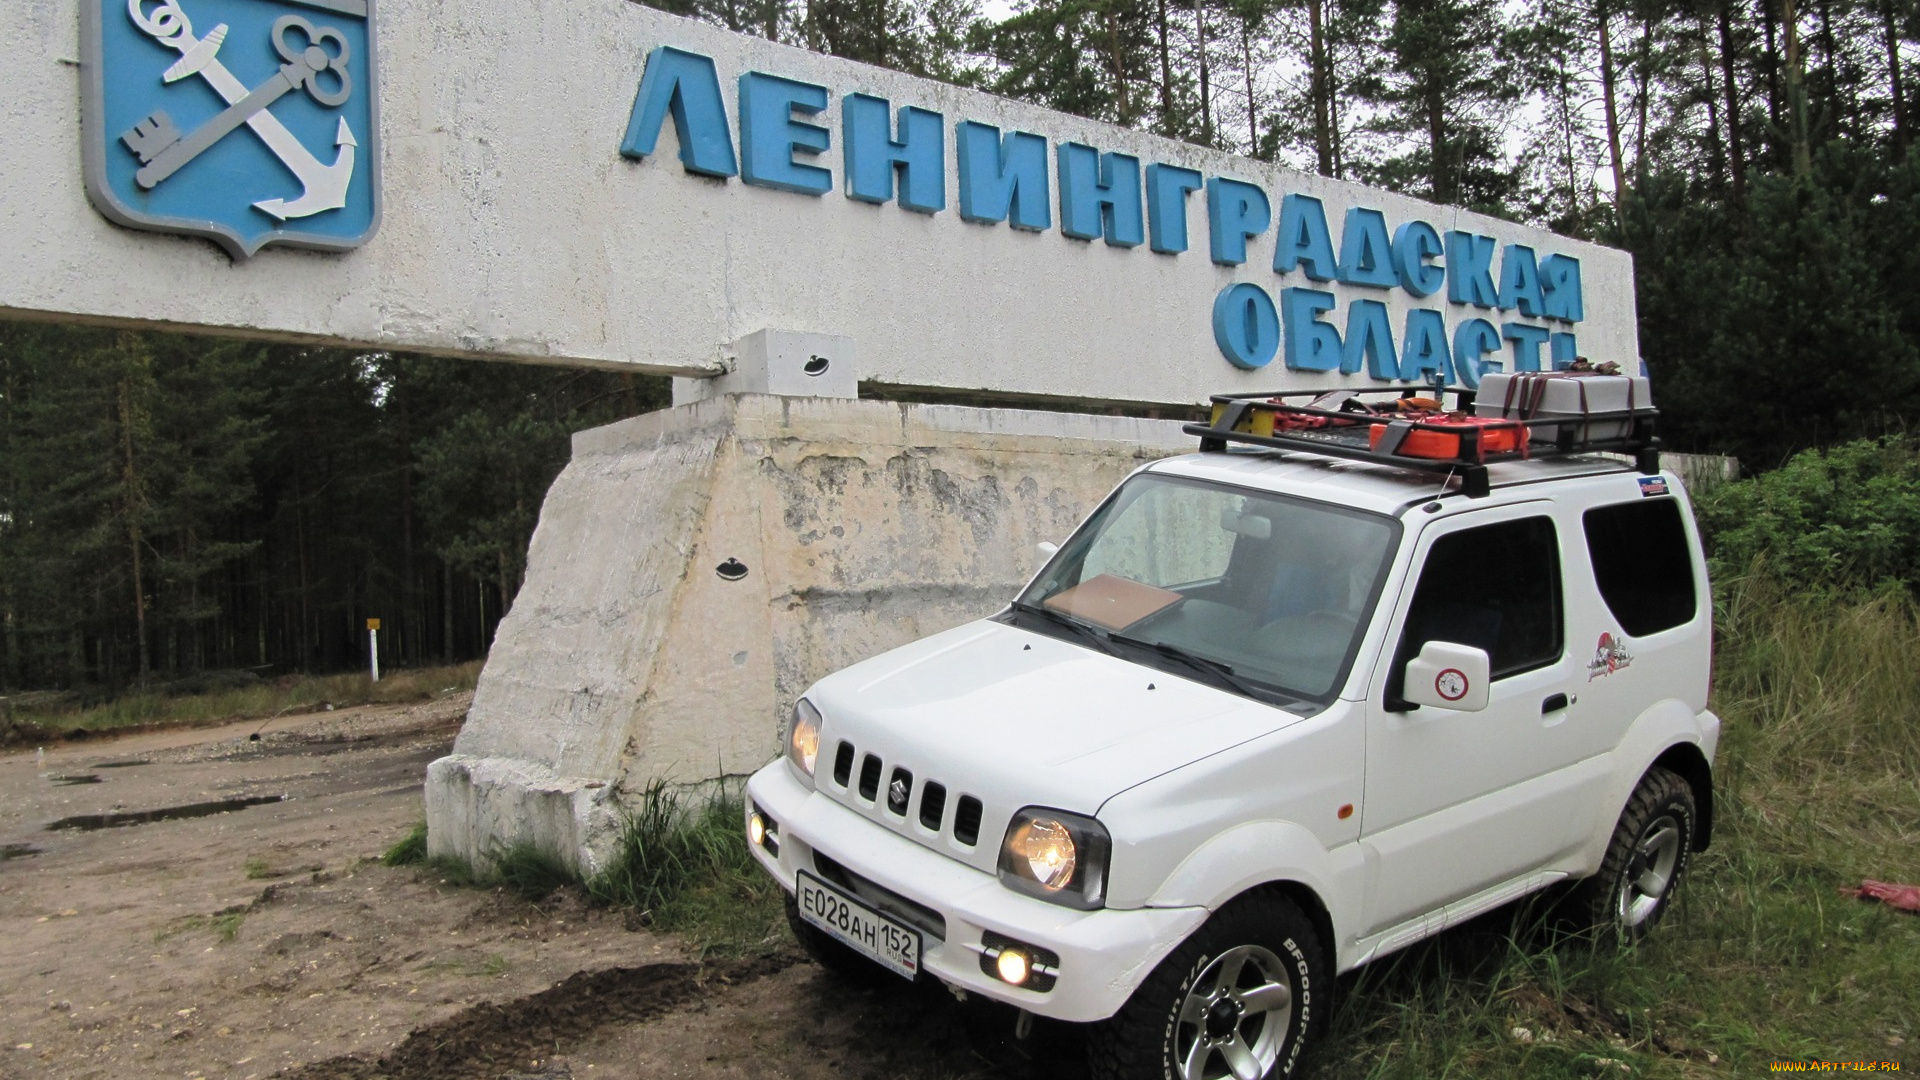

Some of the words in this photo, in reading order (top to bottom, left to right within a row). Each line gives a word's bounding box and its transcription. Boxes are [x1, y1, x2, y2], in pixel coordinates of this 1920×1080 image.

[620, 46, 1584, 323] ЛЕНИНГРАДСКАЯ
[881, 924, 912, 959] 152
[886, 947, 903, 963] RUS
